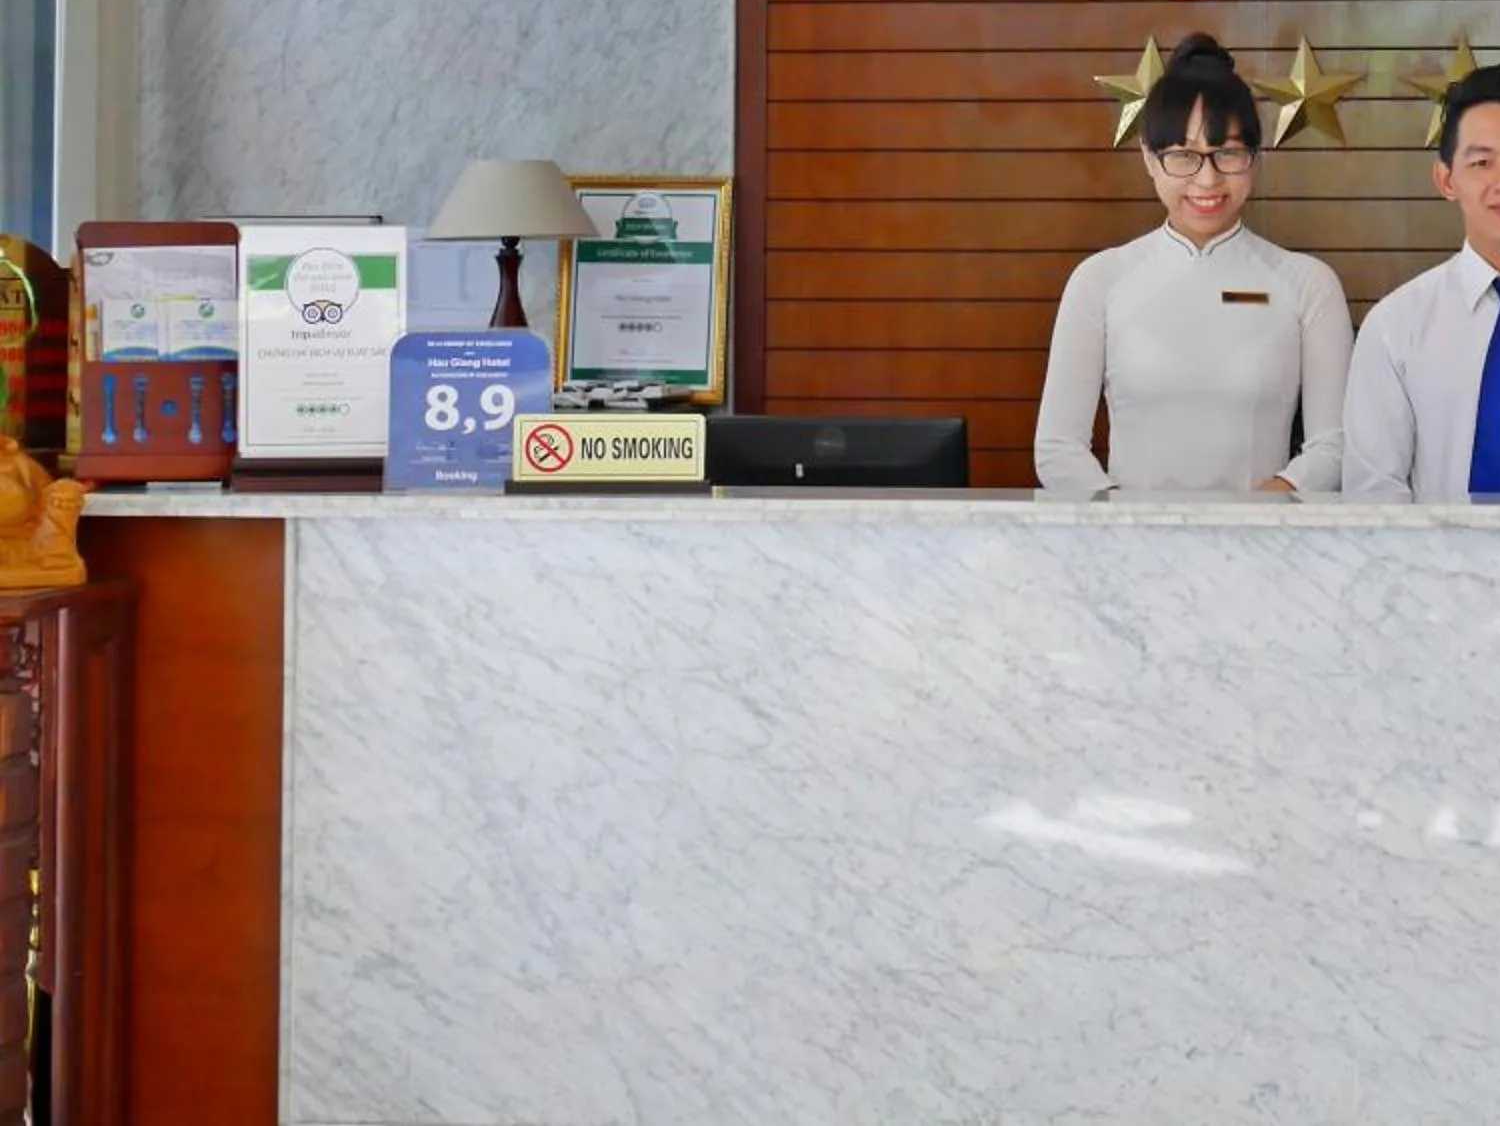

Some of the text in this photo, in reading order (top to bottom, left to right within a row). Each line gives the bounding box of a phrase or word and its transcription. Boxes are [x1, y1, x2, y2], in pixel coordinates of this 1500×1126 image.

[450, 357, 481, 369] Giang
[425, 384, 515, 434] 8,9
[581, 437, 694, 460] NO SMOKING
[435, 470, 478, 482] Booking
